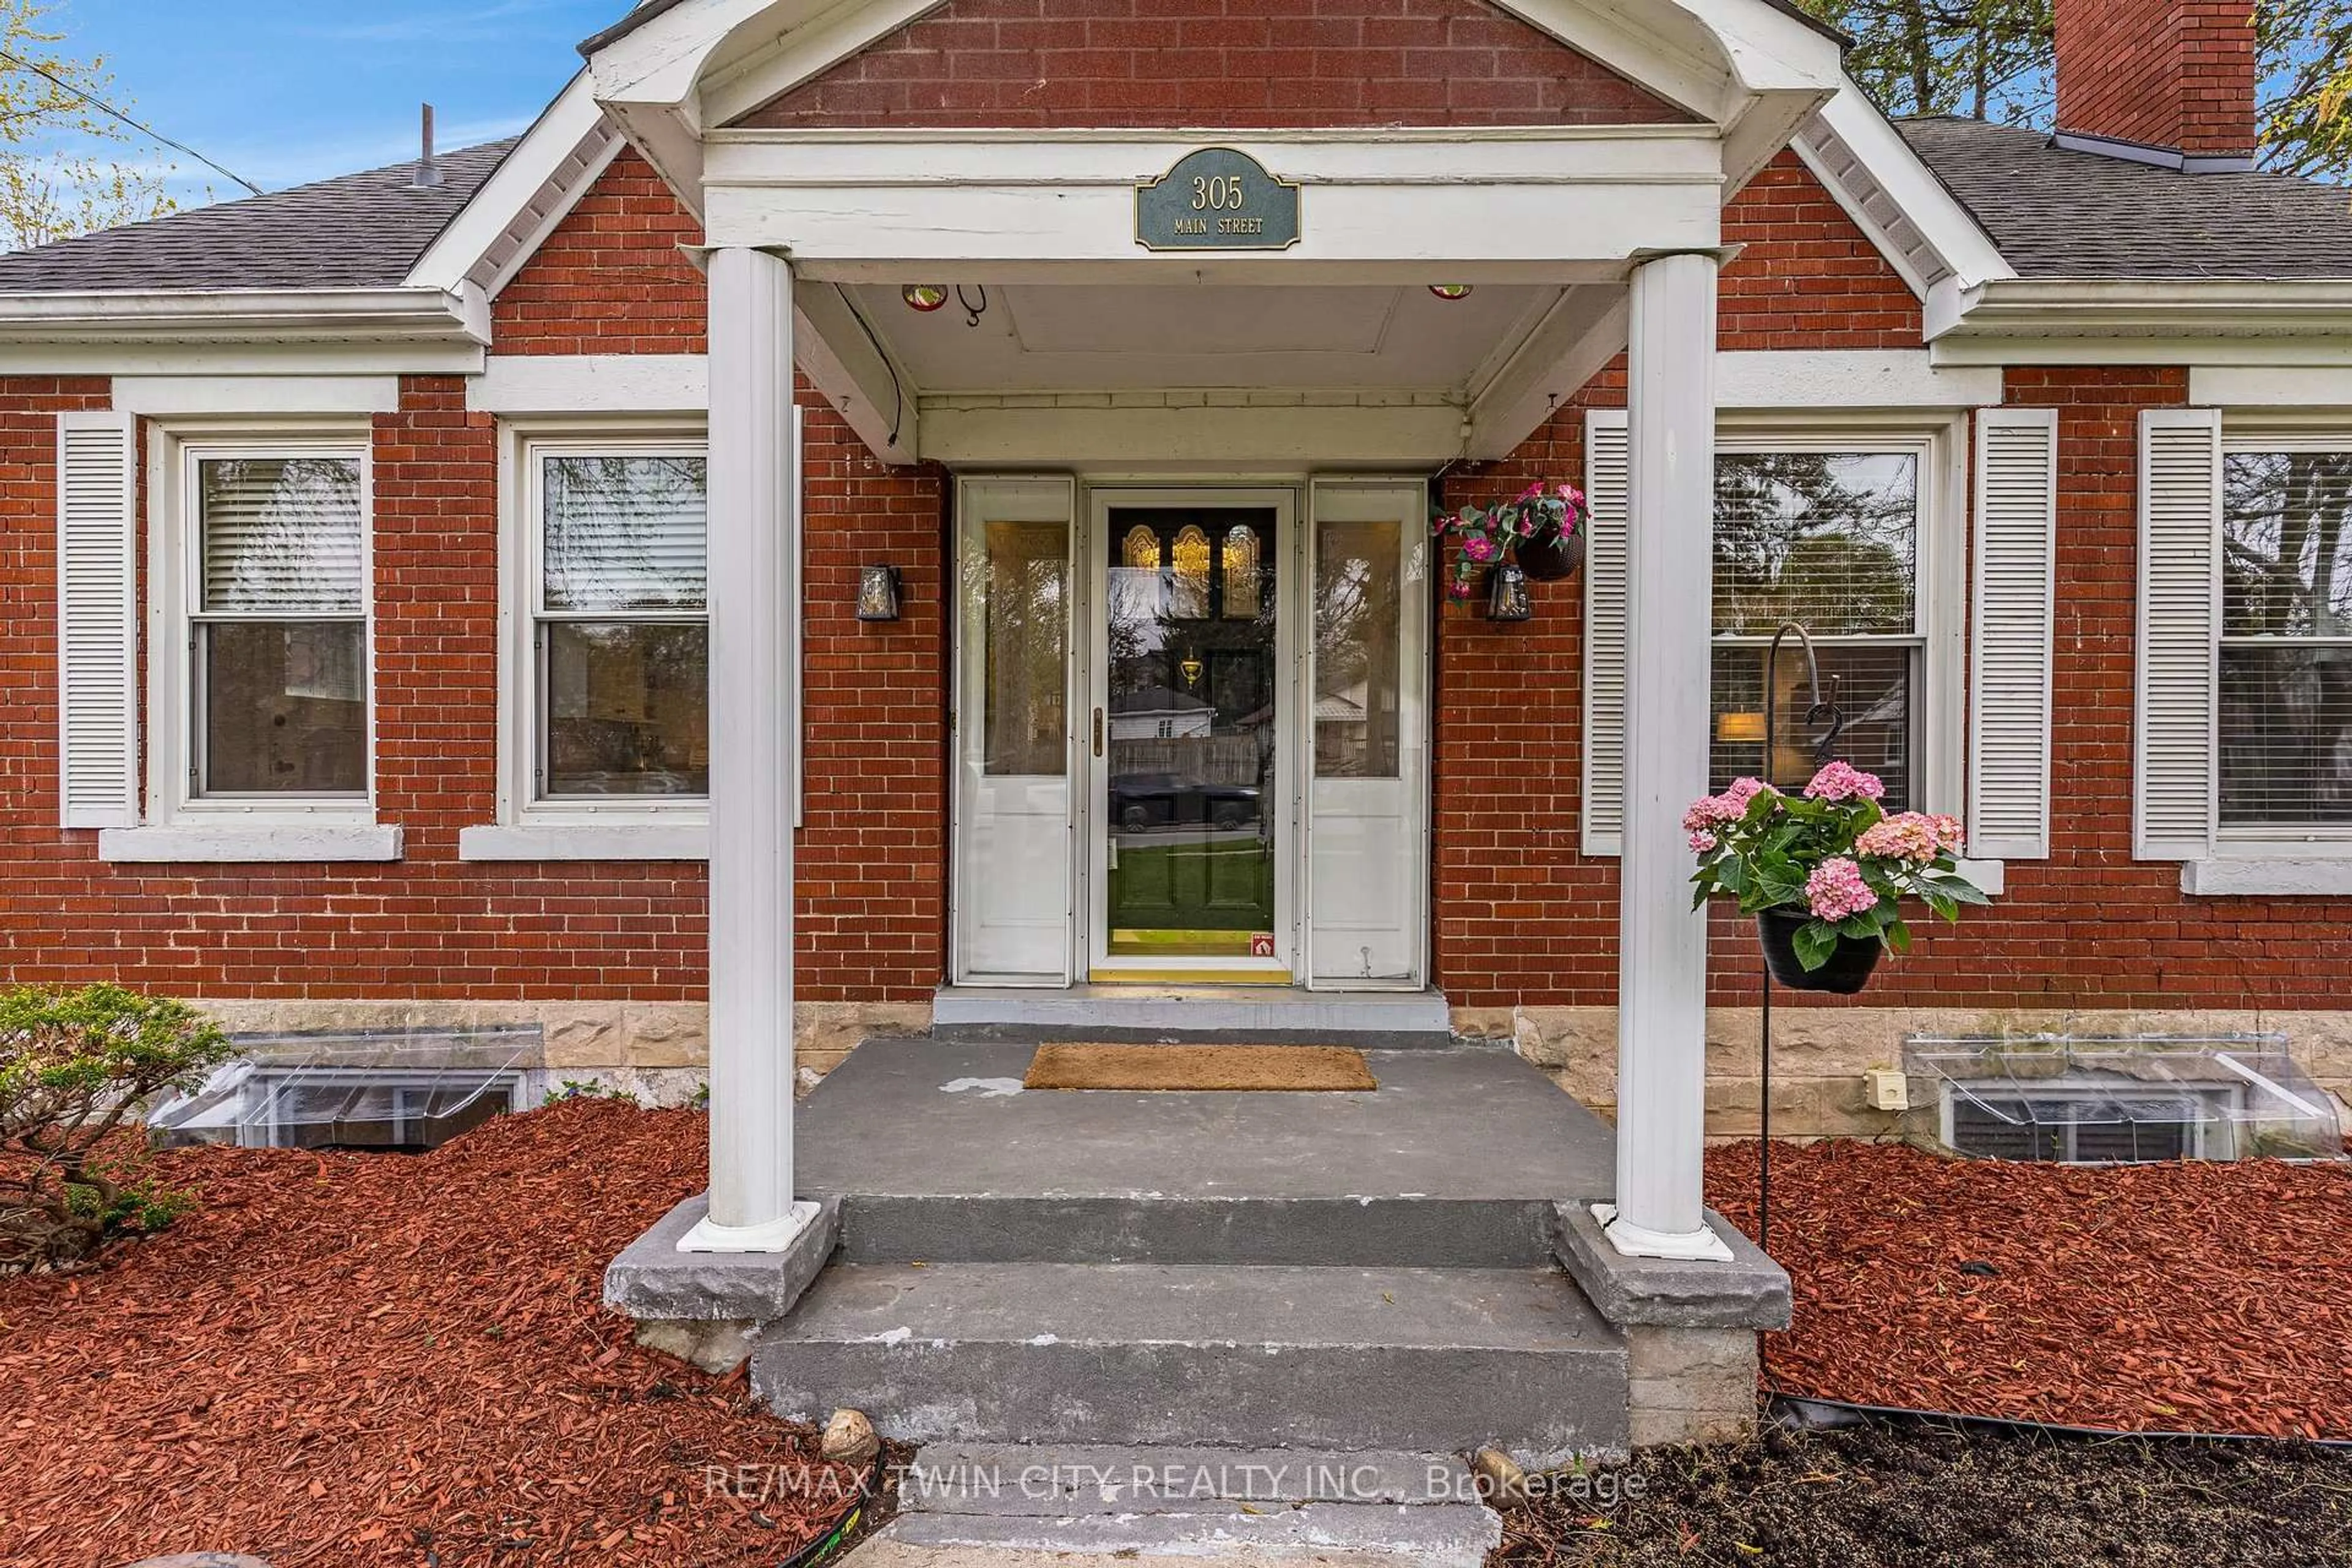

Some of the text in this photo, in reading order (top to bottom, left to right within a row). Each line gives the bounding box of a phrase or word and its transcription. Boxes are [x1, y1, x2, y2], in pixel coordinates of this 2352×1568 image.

[1192, 176, 1243, 210] 305
[1174, 217, 1263, 235] MAIN STREET
